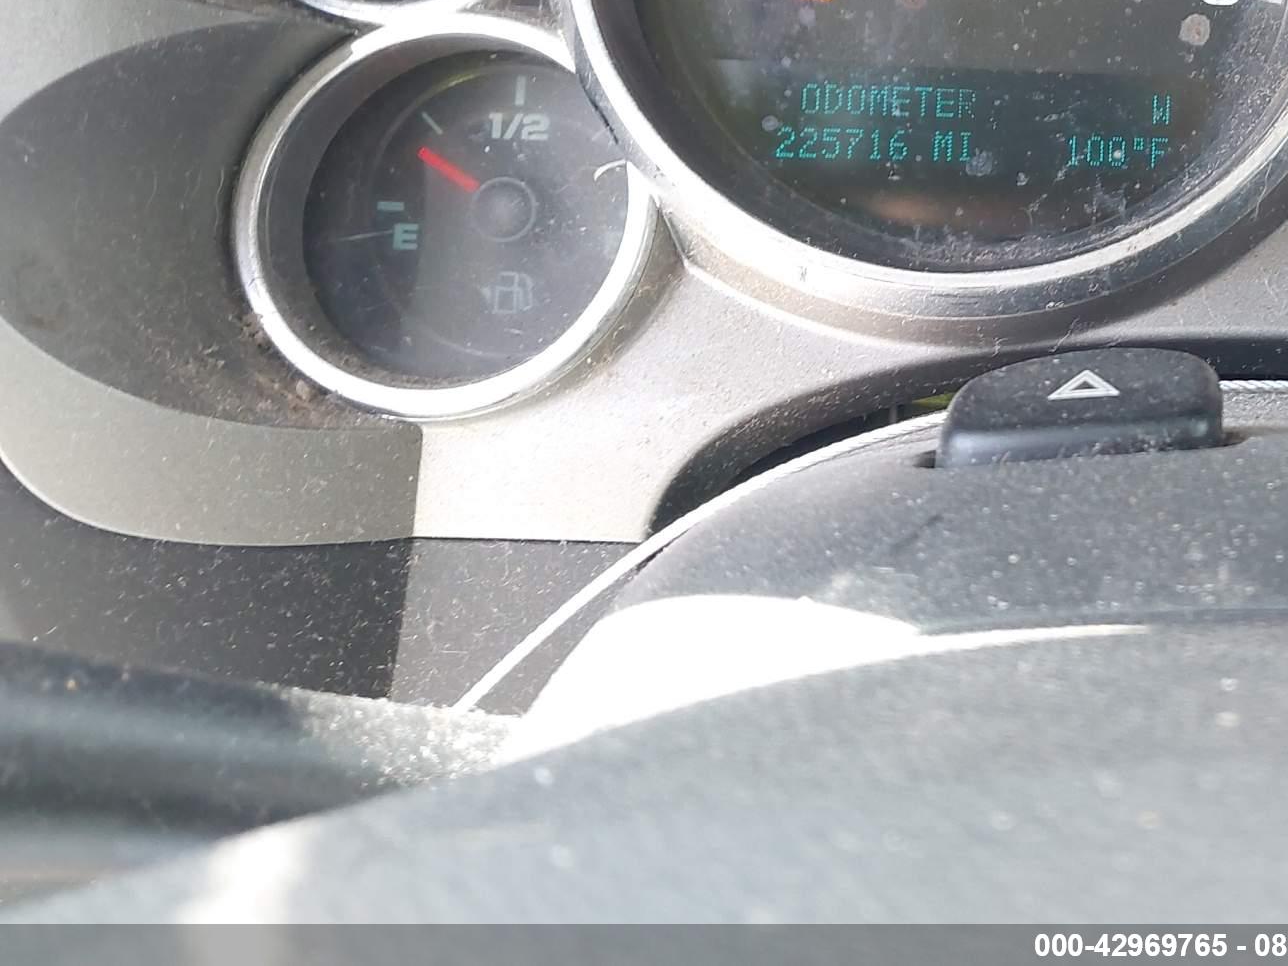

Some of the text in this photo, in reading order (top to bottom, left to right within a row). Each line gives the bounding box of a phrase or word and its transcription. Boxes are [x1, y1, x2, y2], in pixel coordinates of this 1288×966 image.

[801, 83, 976, 119] ODOMETER
[1153, 95, 1171, 125] W
[488, 113, 549, 141] 1/2
[776, 127, 972, 162] 225716 MI
[393, 223, 418, 250] E
